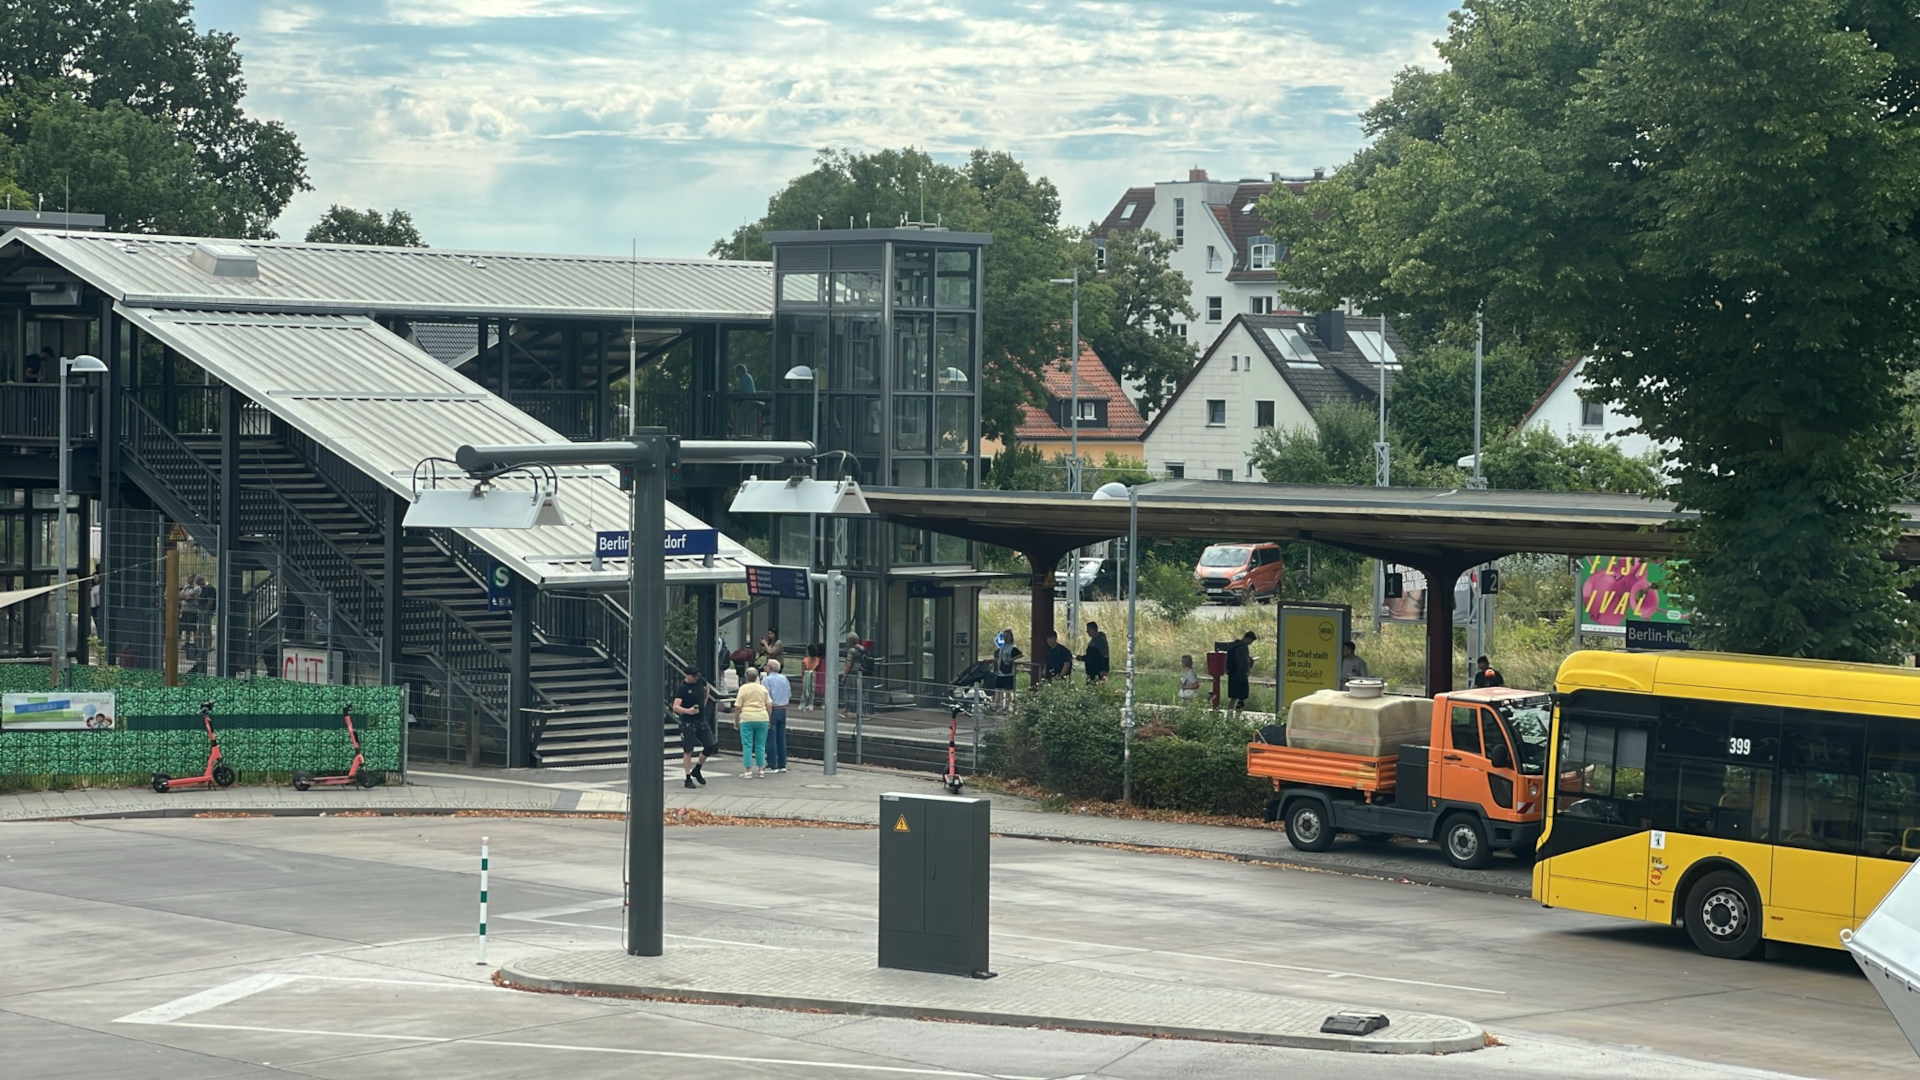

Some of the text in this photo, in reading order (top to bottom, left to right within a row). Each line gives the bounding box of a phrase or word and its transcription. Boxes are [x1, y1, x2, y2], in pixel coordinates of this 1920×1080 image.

[599, 534, 687, 551] Berlin-dorf
[495, 566, 509, 587] S
[1489, 573, 1498, 592] 2
[1387, 577, 1395, 596] 1
[1585, 590, 1646, 616] IVAL
[1287, 649, 1328, 660] Ihr Chef stellt
[1287, 658, 1311, 668] Sie aufs
[1729, 737, 1751, 755] 399
